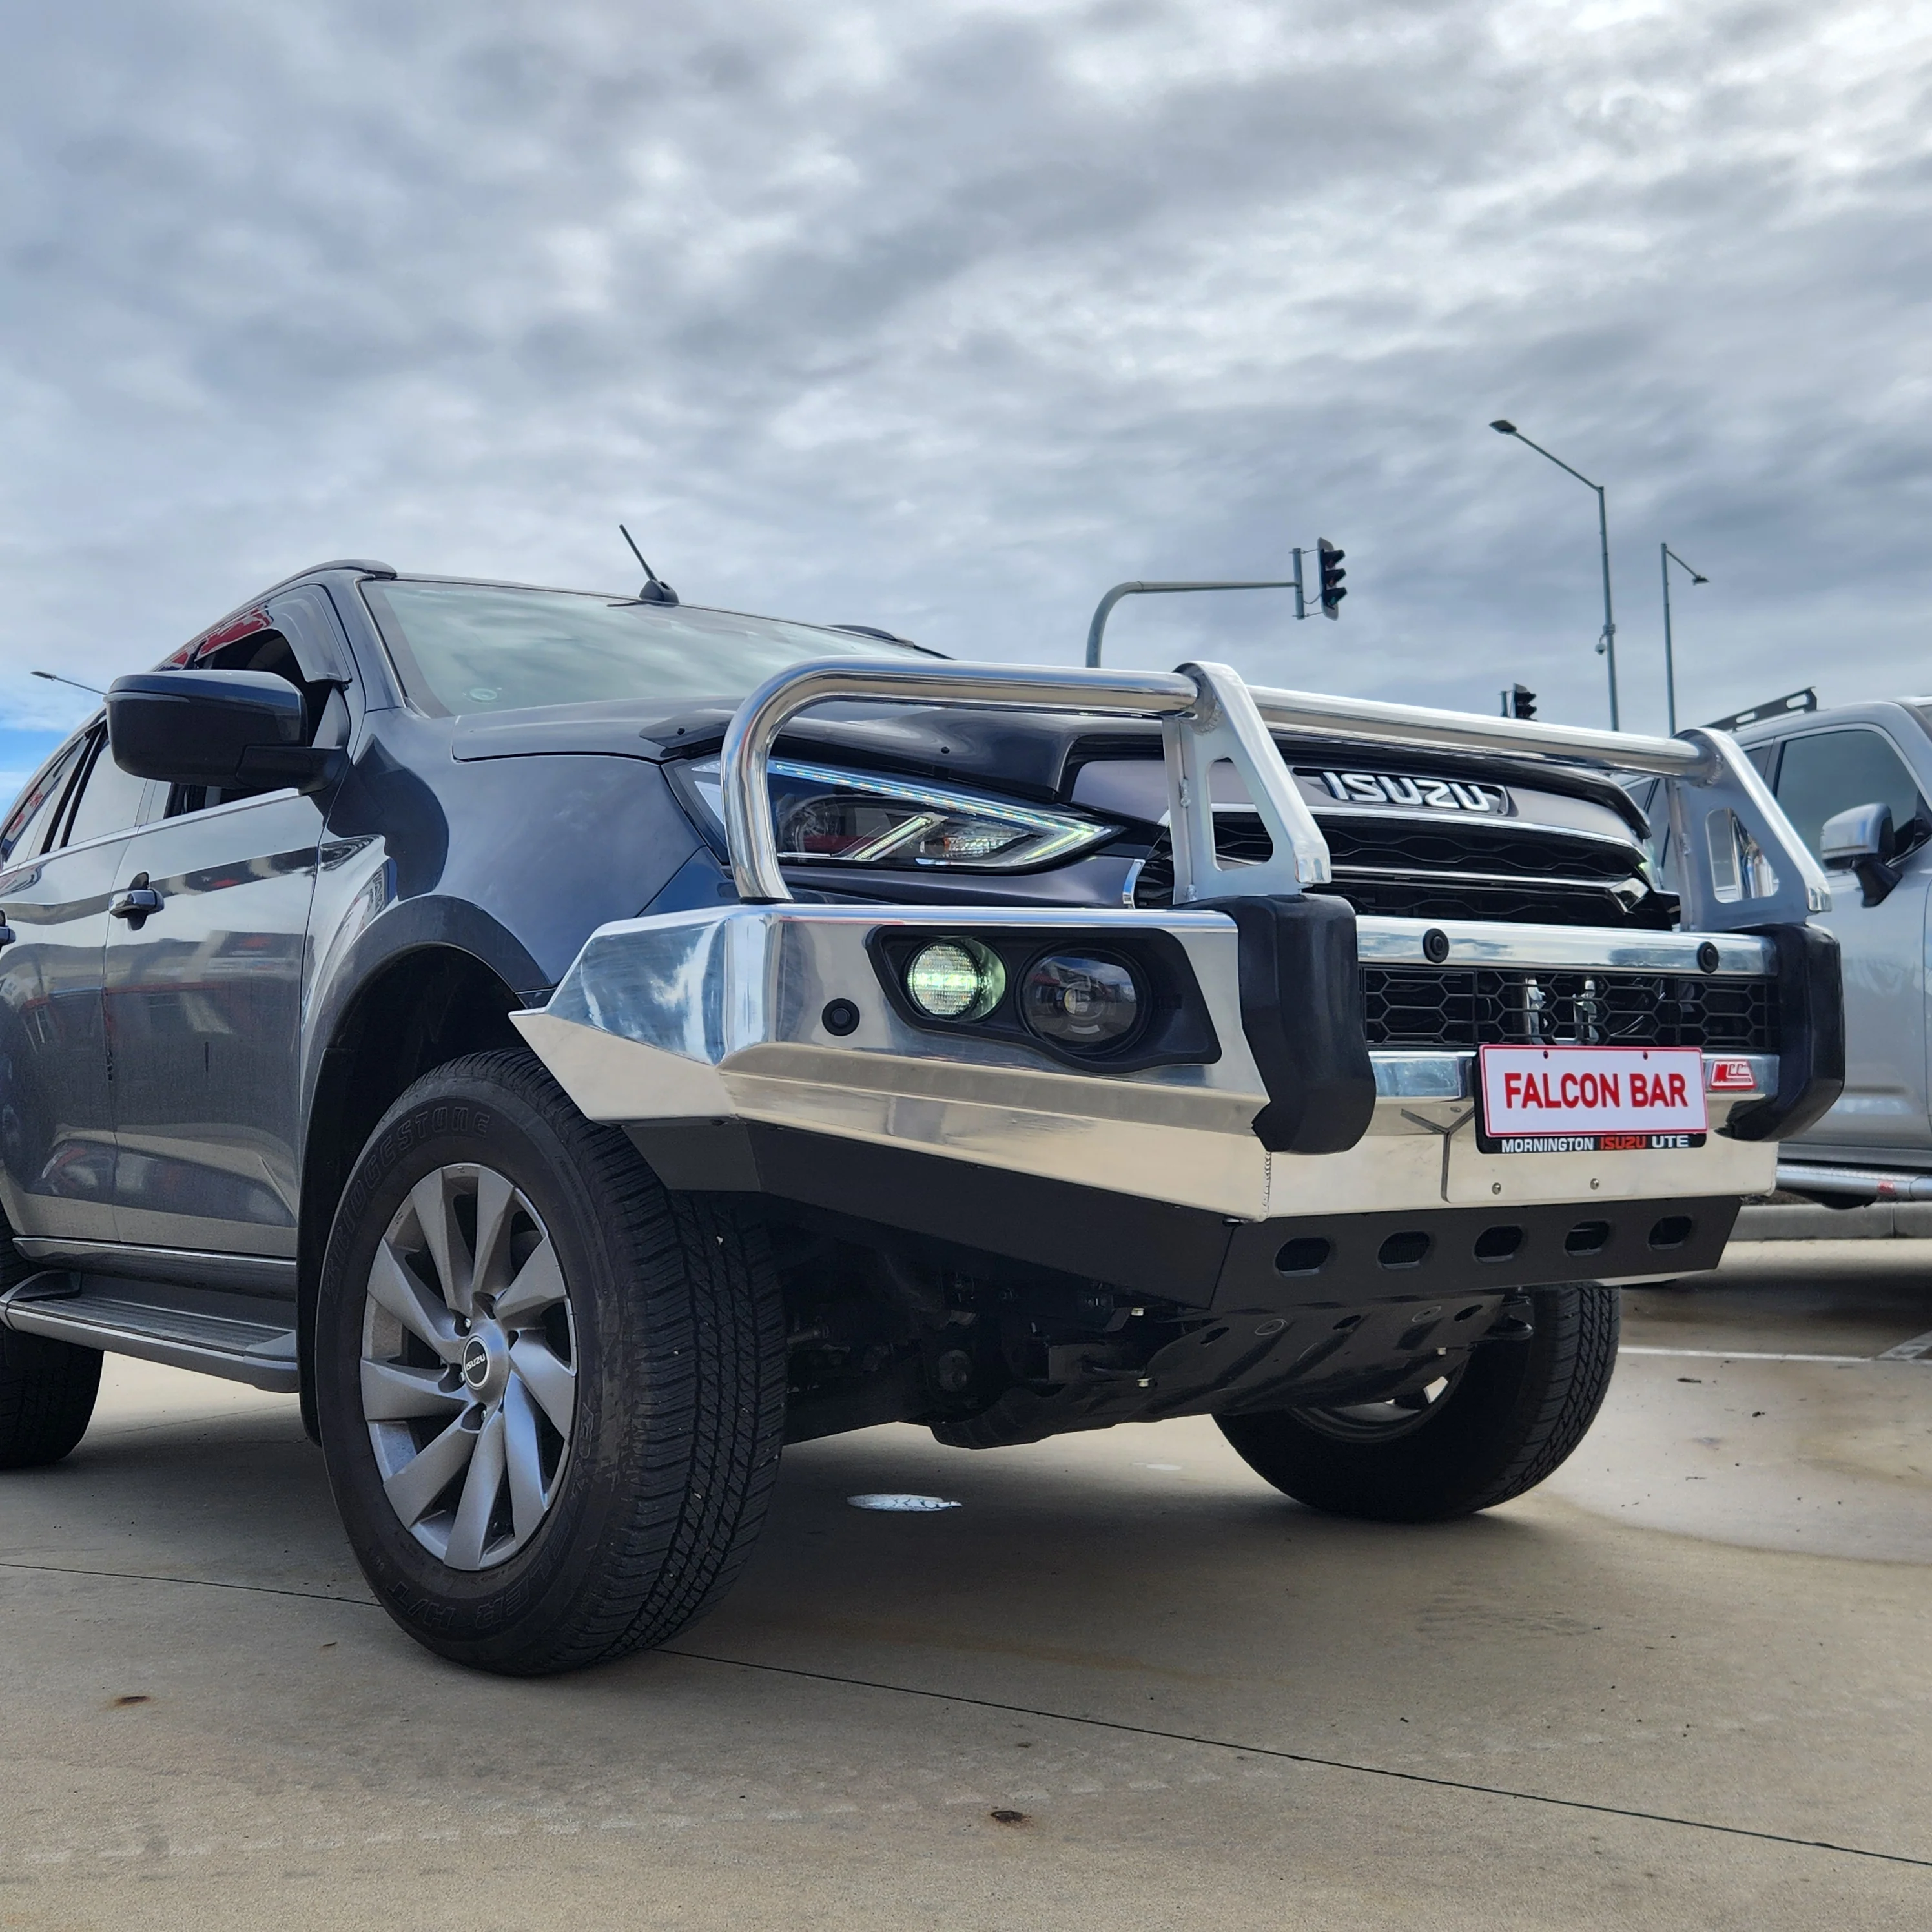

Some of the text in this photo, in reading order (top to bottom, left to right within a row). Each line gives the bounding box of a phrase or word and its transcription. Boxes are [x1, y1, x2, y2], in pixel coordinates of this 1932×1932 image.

[1323, 772, 1490, 811] ISUZU
[1504, 1072, 1689, 1109] FALCON BAR
[1501, 1135, 1689, 1153] MORNINGTON ISUZU UTE
[465, 1353, 486, 1371] ISUZU
